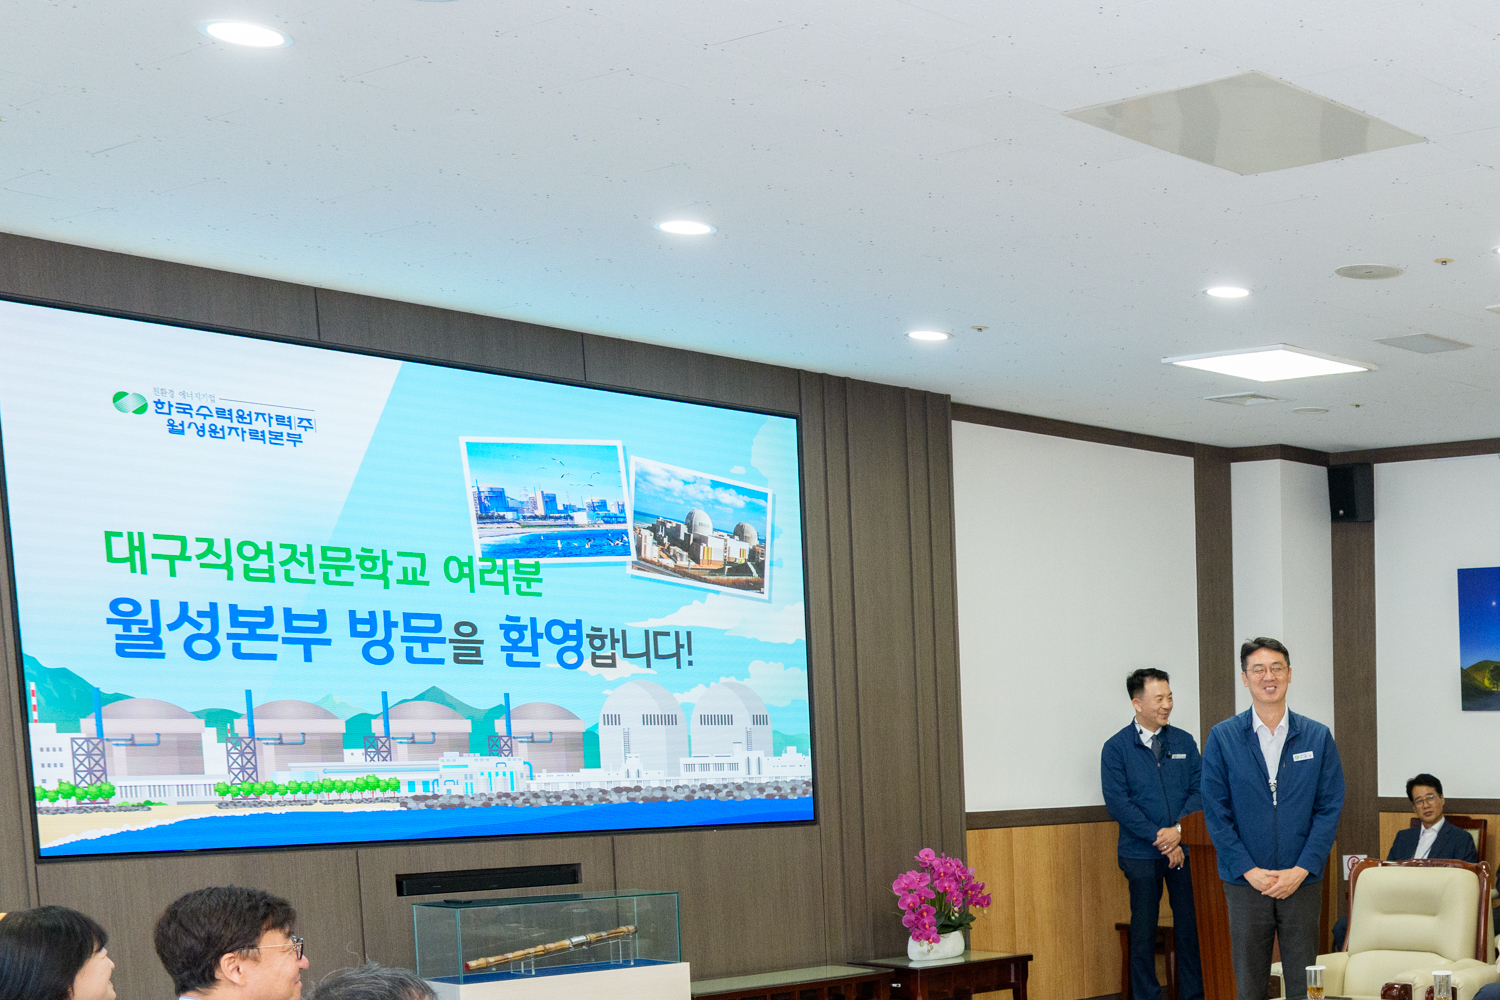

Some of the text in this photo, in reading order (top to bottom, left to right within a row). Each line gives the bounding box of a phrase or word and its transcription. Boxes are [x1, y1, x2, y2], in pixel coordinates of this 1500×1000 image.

[152, 386, 216, 404] 친환경 에너지기업
[166, 418, 304, 448] 월성원자력본부
[104, 530, 544, 598] 대구직업전문학교 여러분
[106, 597, 694, 670] 월성본부 방문을 환영합니다!
